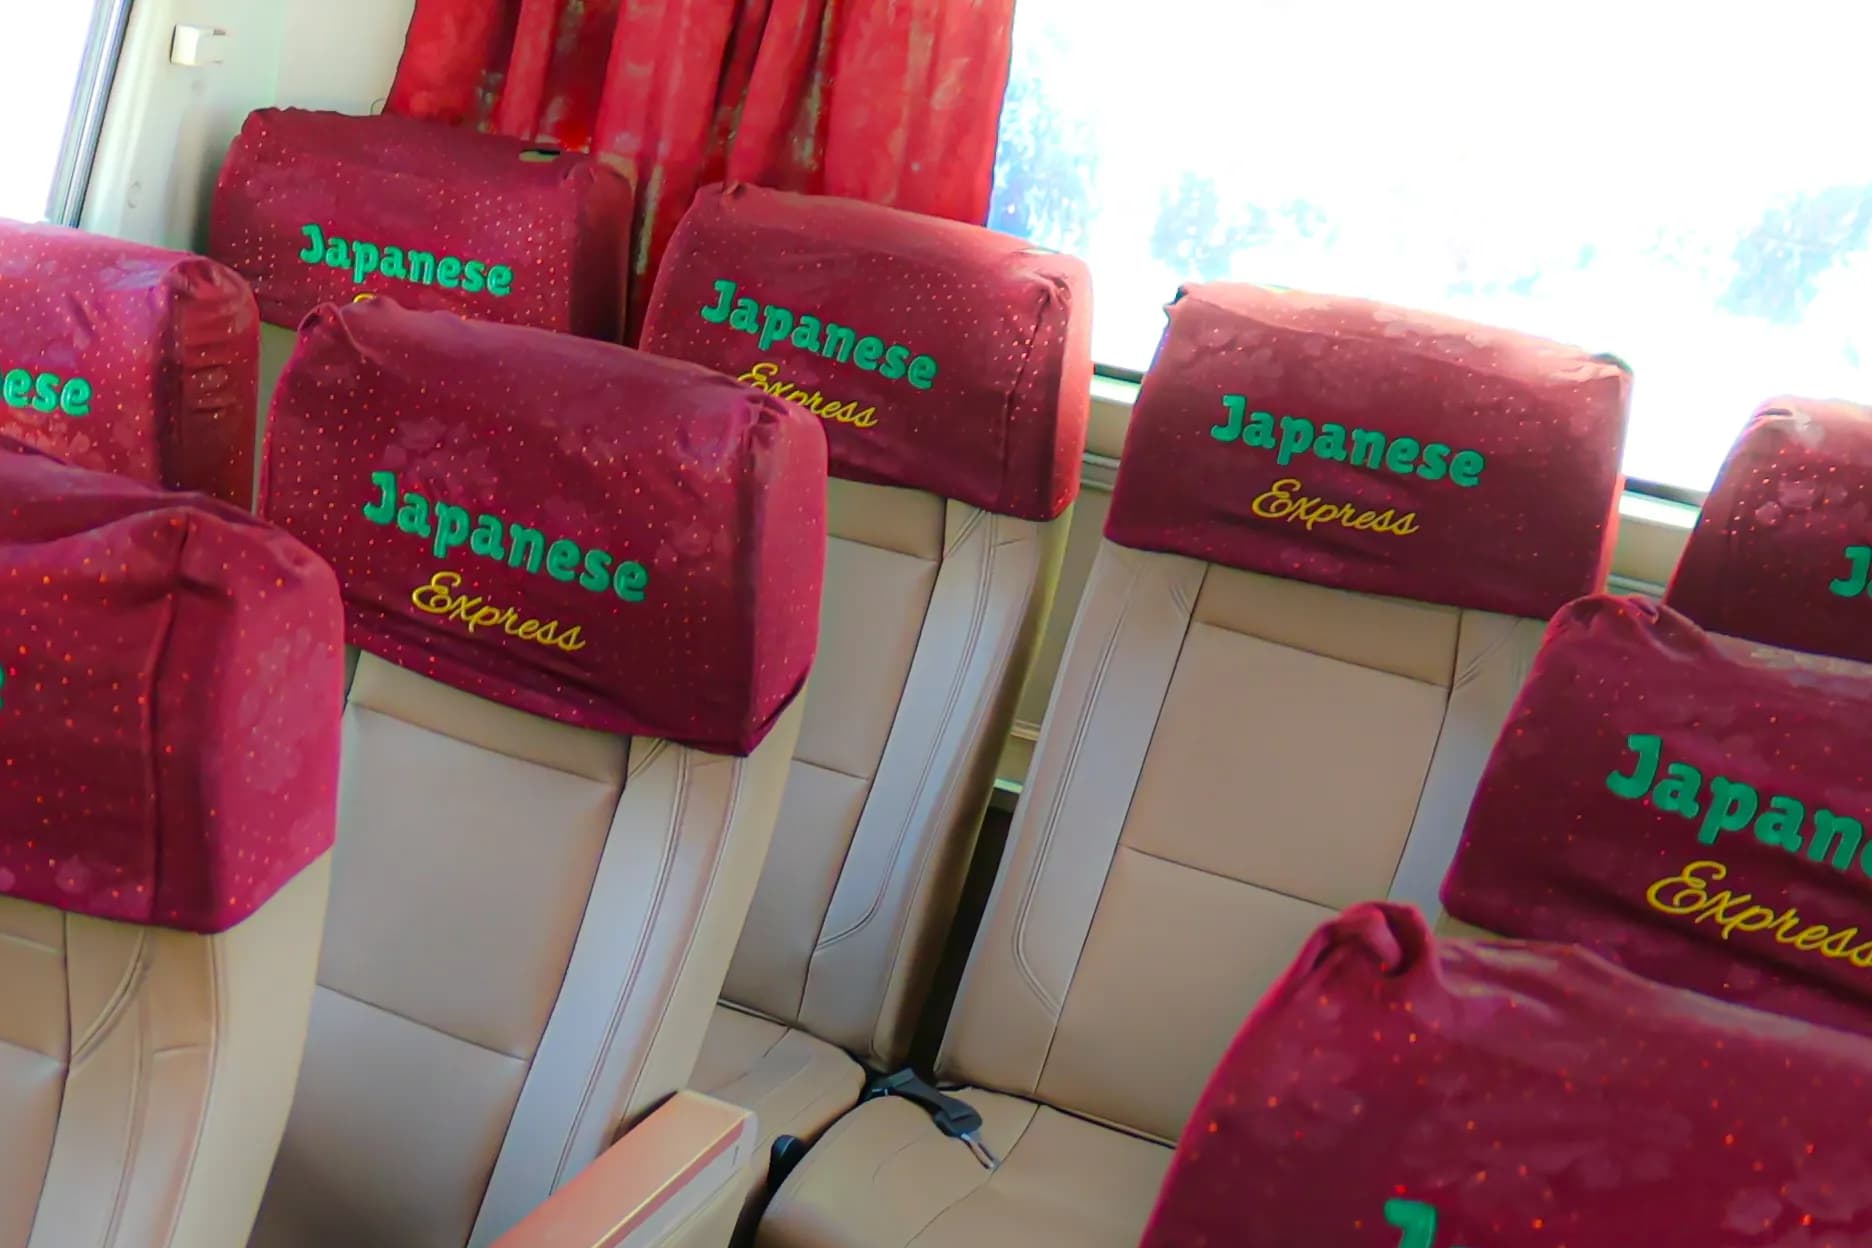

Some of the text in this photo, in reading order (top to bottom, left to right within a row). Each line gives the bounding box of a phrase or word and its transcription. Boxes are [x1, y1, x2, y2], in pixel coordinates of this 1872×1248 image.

[299, 222, 514, 296] Japanese
[699, 277, 939, 390] Japanese
[1210, 393, 1485, 487] Japanese
[362, 470, 649, 603] Japanese
[1251, 478, 1419, 536] Express
[410, 570, 585, 653] Express
[1605, 733, 1872, 880] Japan
